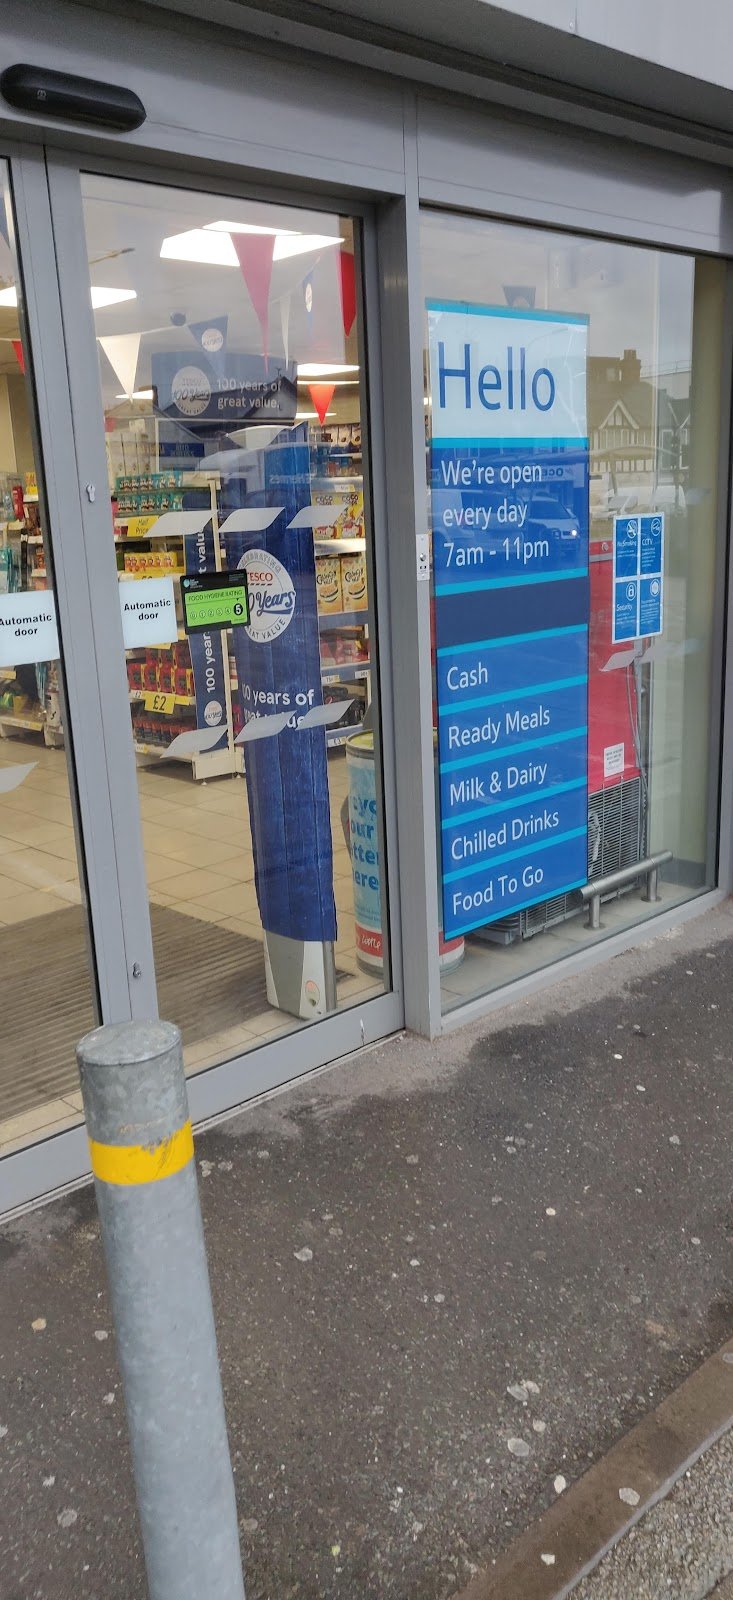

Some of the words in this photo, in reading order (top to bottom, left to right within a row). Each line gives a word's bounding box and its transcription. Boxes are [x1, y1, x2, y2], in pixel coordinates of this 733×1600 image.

[217, 378, 237, 391] 100
[240, 381, 268, 393] years
[270, 379, 281, 391] of
[438, 341, 556, 412] Hello
[217, 396, 246, 409] great
[249, 396, 280, 409] value.
[500, 464, 543, 489] open
[442, 506, 492, 530] every
[497, 498, 528, 528] day
[196, 532, 207, 563] valu
[443, 542, 484, 567] 7am
[502, 536, 549, 565] 11pm
[124, 598, 171, 611] Automatic
[138, 610, 159, 621] door
[235, 604, 242, 615] 5
[255, 591, 296, 617] Years
[14, 628, 38, 637] door
[262, 618, 286, 640] VALUE
[203, 631, 216, 664] year
[205, 668, 216, 693] 100
[446, 662, 489, 691] Cash
[153, 695, 167, 711] £2
[253, 690, 291, 706] years
[295, 688, 315, 706] of
[448, 716, 501, 750] Ready
[505, 705, 551, 735] Meals
[450, 777, 485, 806] Milk
[489, 771, 502, 793] &
[507, 761, 548, 790] Dairy
[350, 819, 375, 840] our
[451, 822, 507, 860] Chilled
[511, 809, 560, 840] Drinks
[452, 882, 494, 916] Food
[497, 875, 519, 897] To
[522, 865, 544, 888] Go
